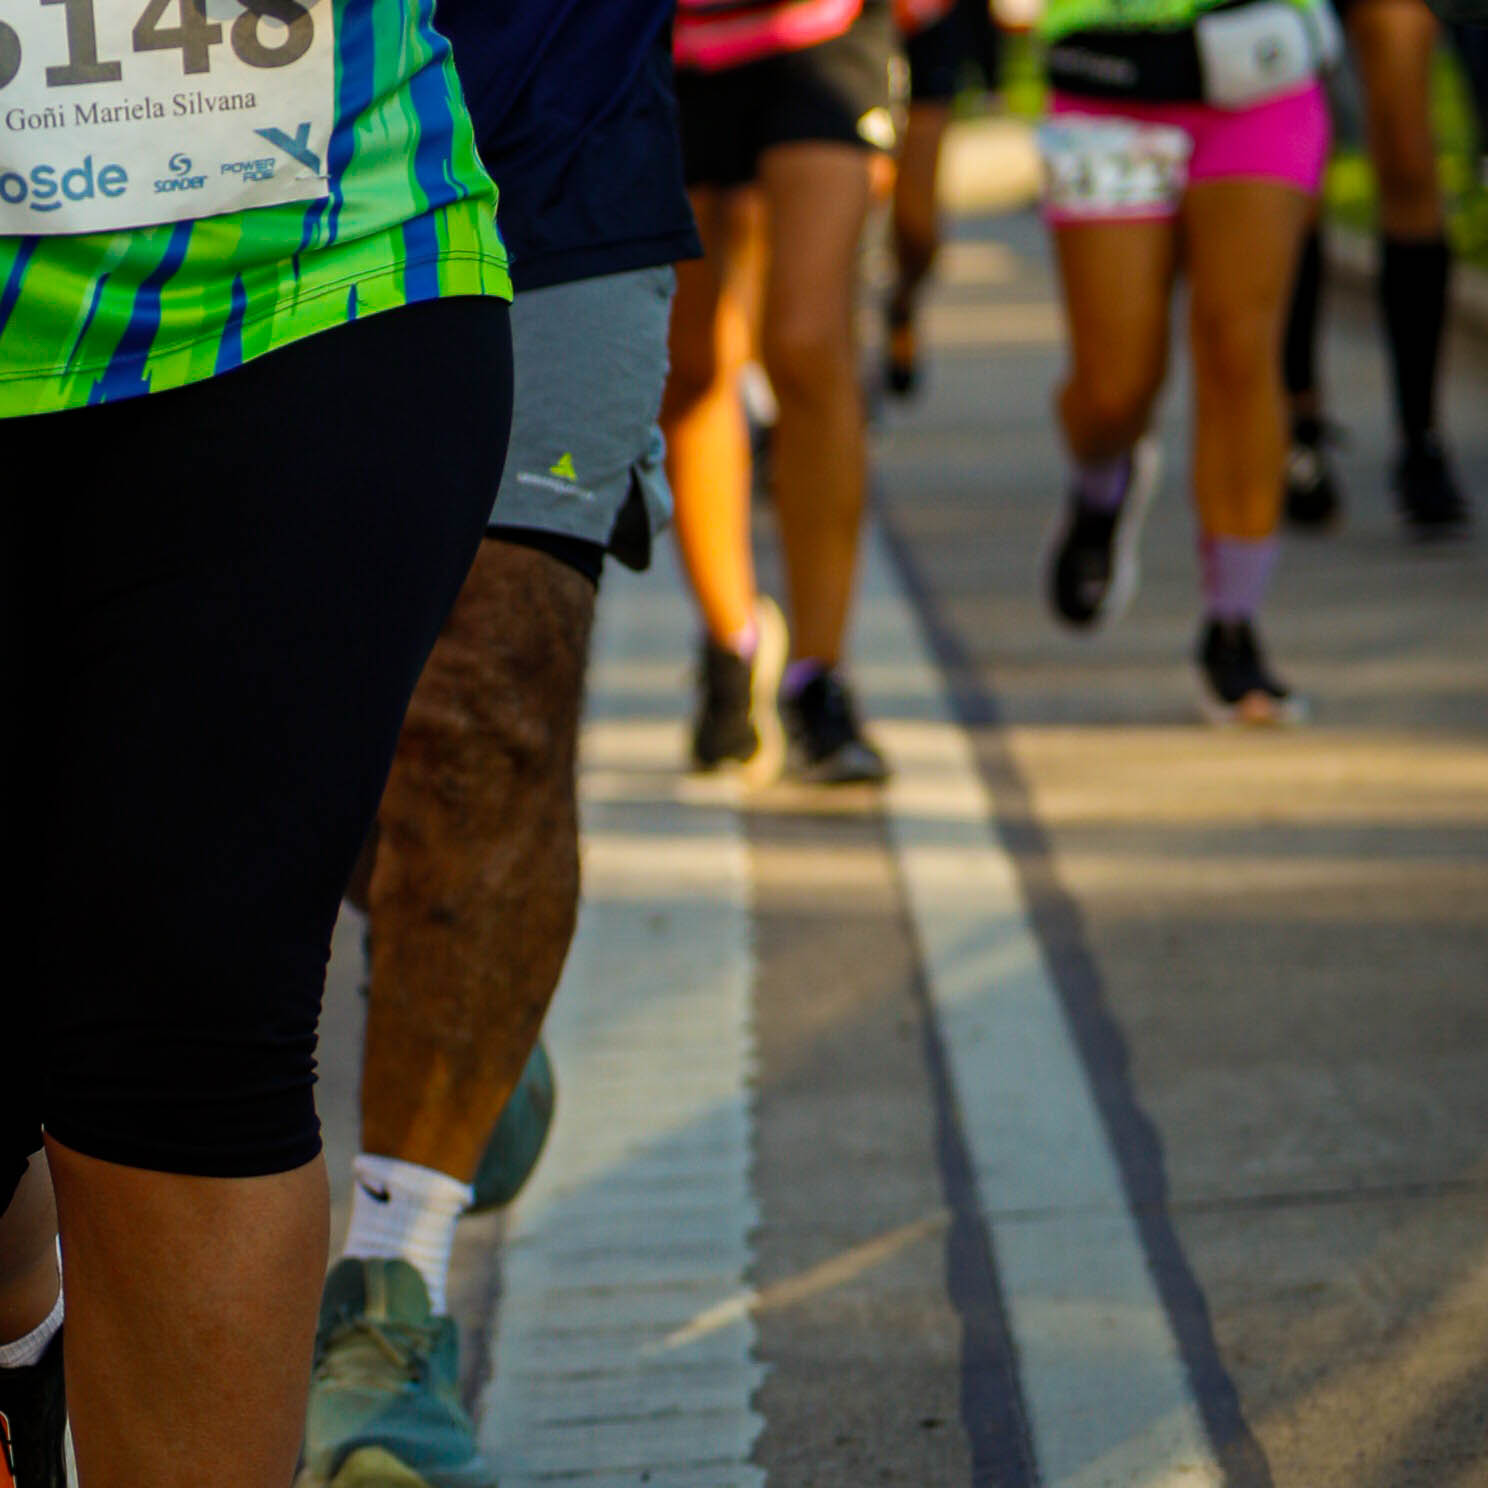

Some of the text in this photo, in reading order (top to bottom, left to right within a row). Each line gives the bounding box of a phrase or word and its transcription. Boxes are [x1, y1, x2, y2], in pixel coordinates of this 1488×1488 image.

[4, 90, 258, 133] Goñi Mariela Silvana
[220, 157, 276, 175] POWER
